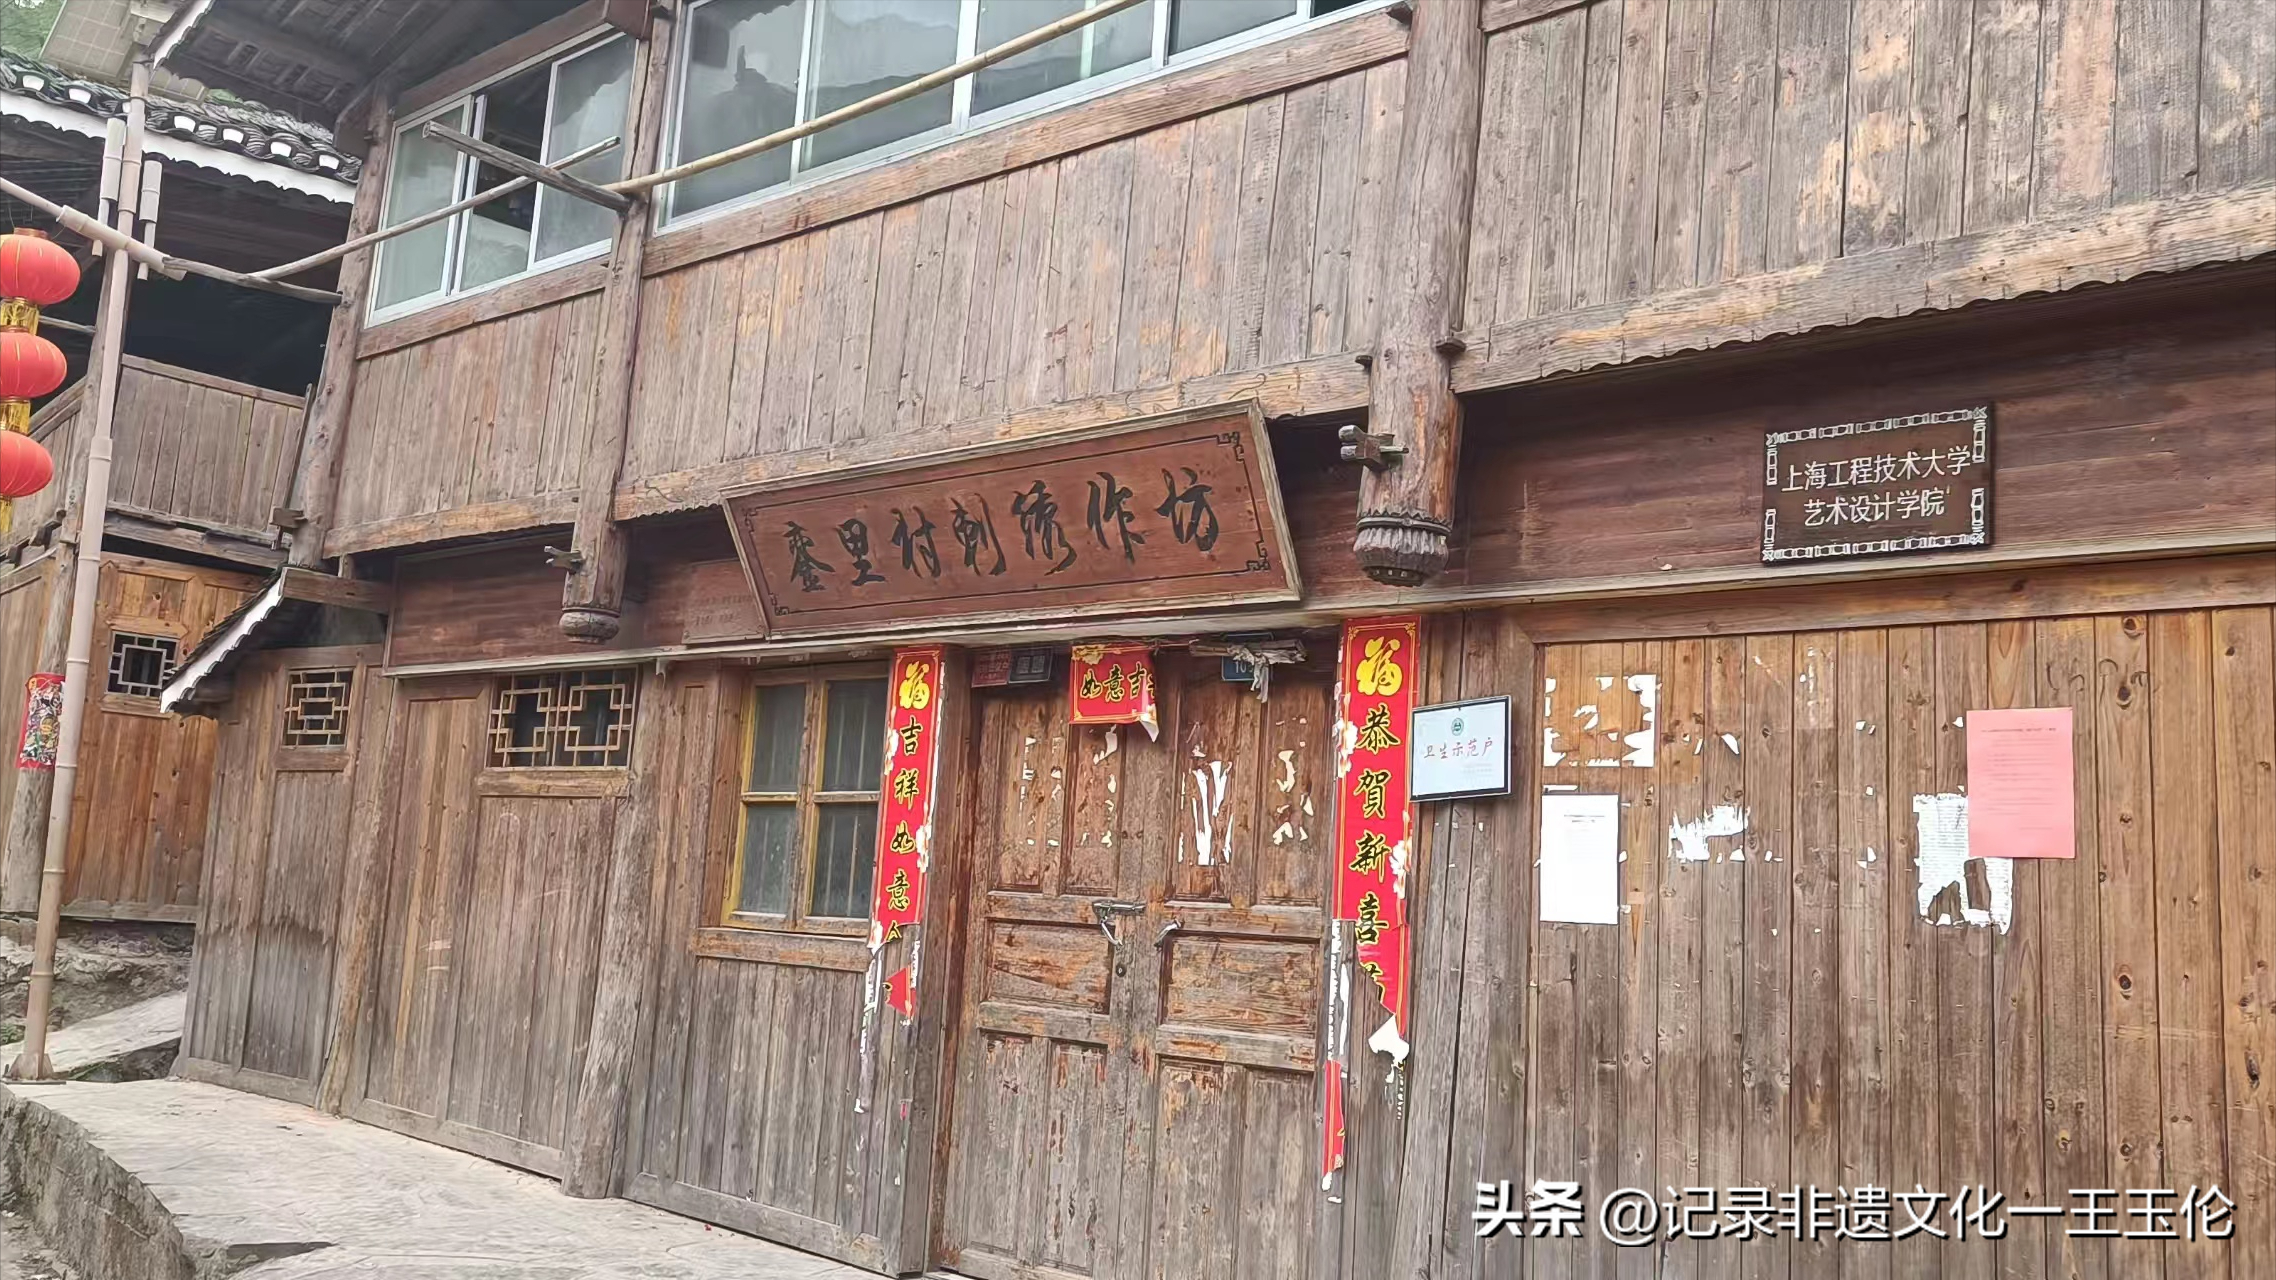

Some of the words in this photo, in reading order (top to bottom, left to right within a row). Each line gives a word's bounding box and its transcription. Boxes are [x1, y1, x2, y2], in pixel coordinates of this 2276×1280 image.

[1781, 446, 1971, 493] 上海工程技术大学
[1804, 488, 1945, 527] 艺术设计学院
[1424, 737, 1494, 759] 卫生示范户
